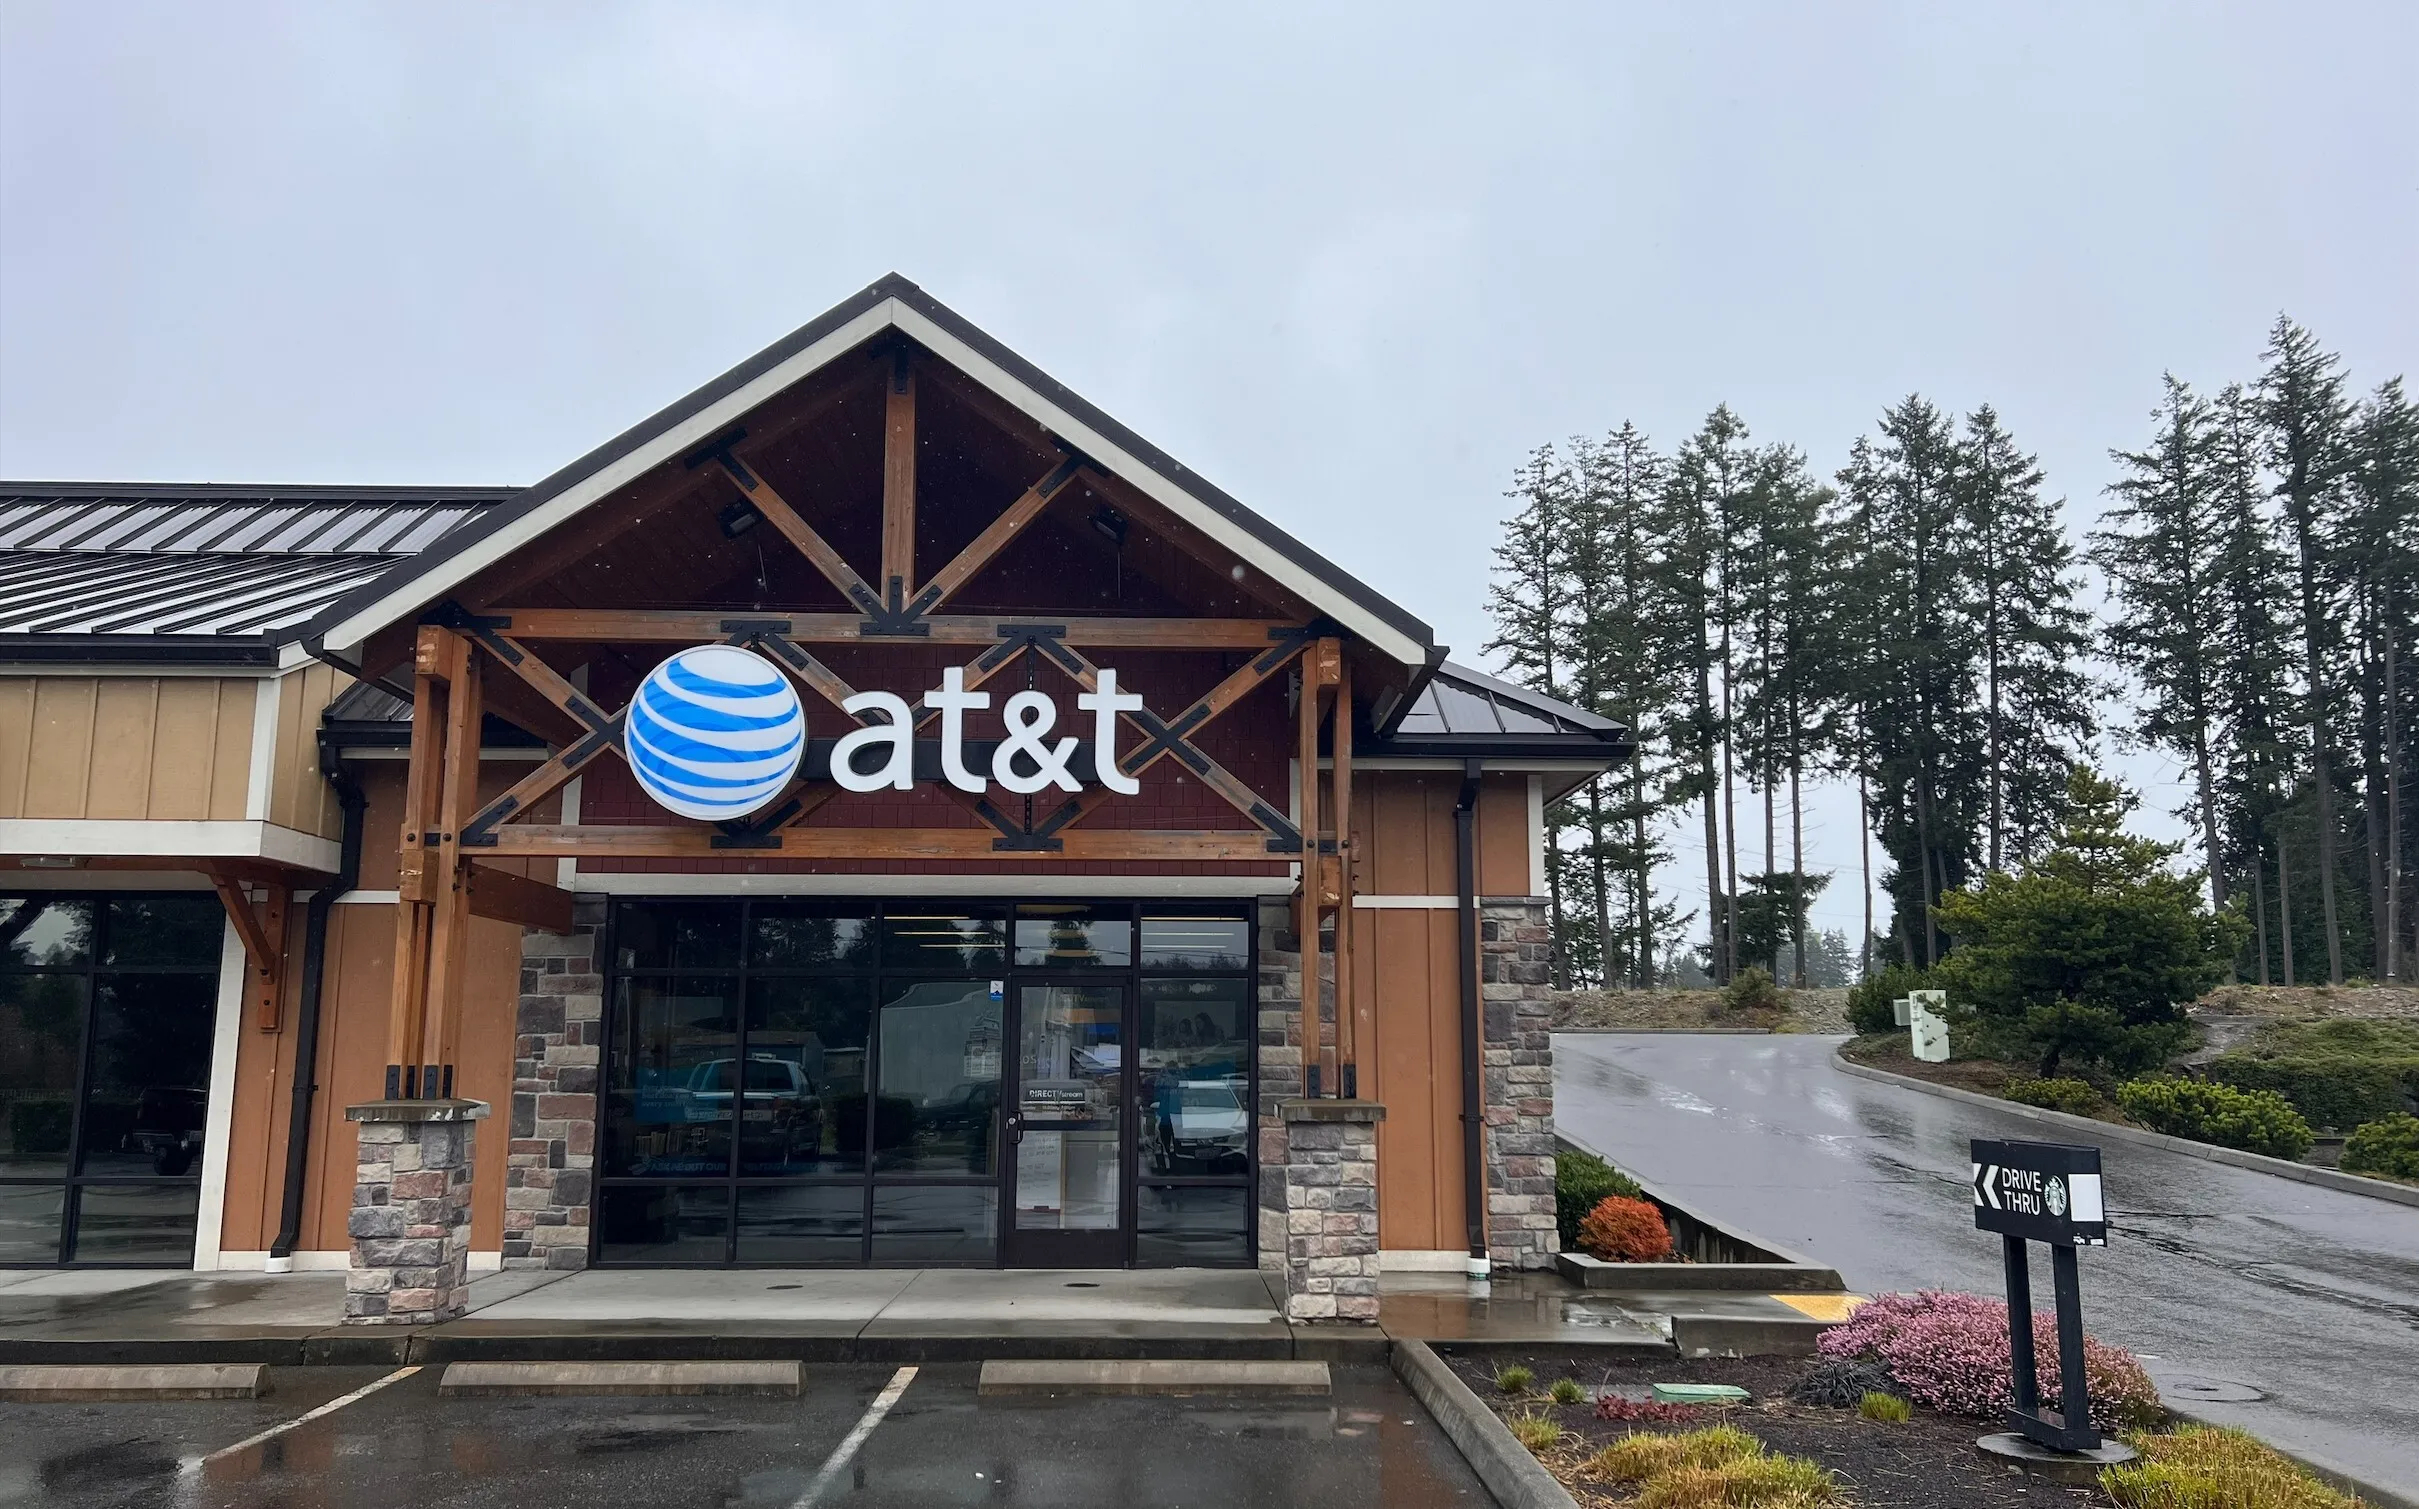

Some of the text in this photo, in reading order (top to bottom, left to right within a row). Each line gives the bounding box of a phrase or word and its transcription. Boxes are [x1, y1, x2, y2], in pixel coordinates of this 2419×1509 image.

[829, 665, 1144, 796] at&t
[2001, 1166, 2043, 1193] DRIVE
[2003, 1190, 2041, 1216] THRU
